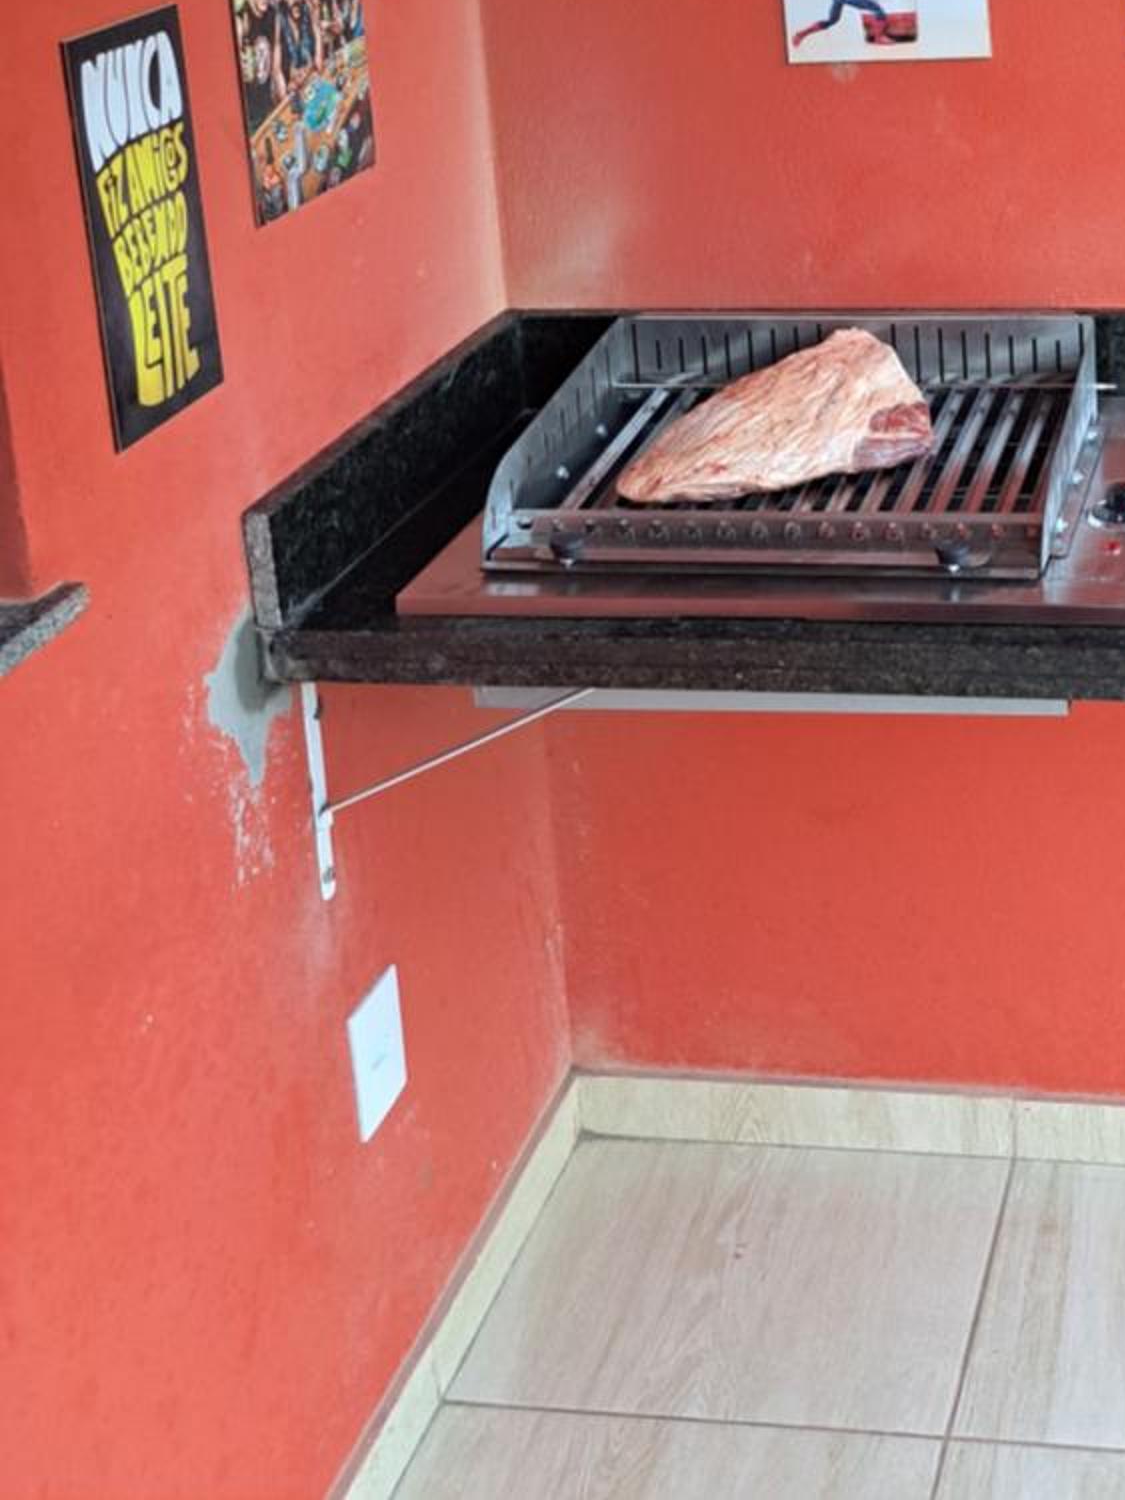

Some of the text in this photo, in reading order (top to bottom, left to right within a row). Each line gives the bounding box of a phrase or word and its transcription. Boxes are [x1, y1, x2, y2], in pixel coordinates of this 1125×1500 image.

[81, 30, 183, 173] NUNCA
[112, 190, 188, 300] BEBENDO
[128, 253, 201, 406] LEITE
